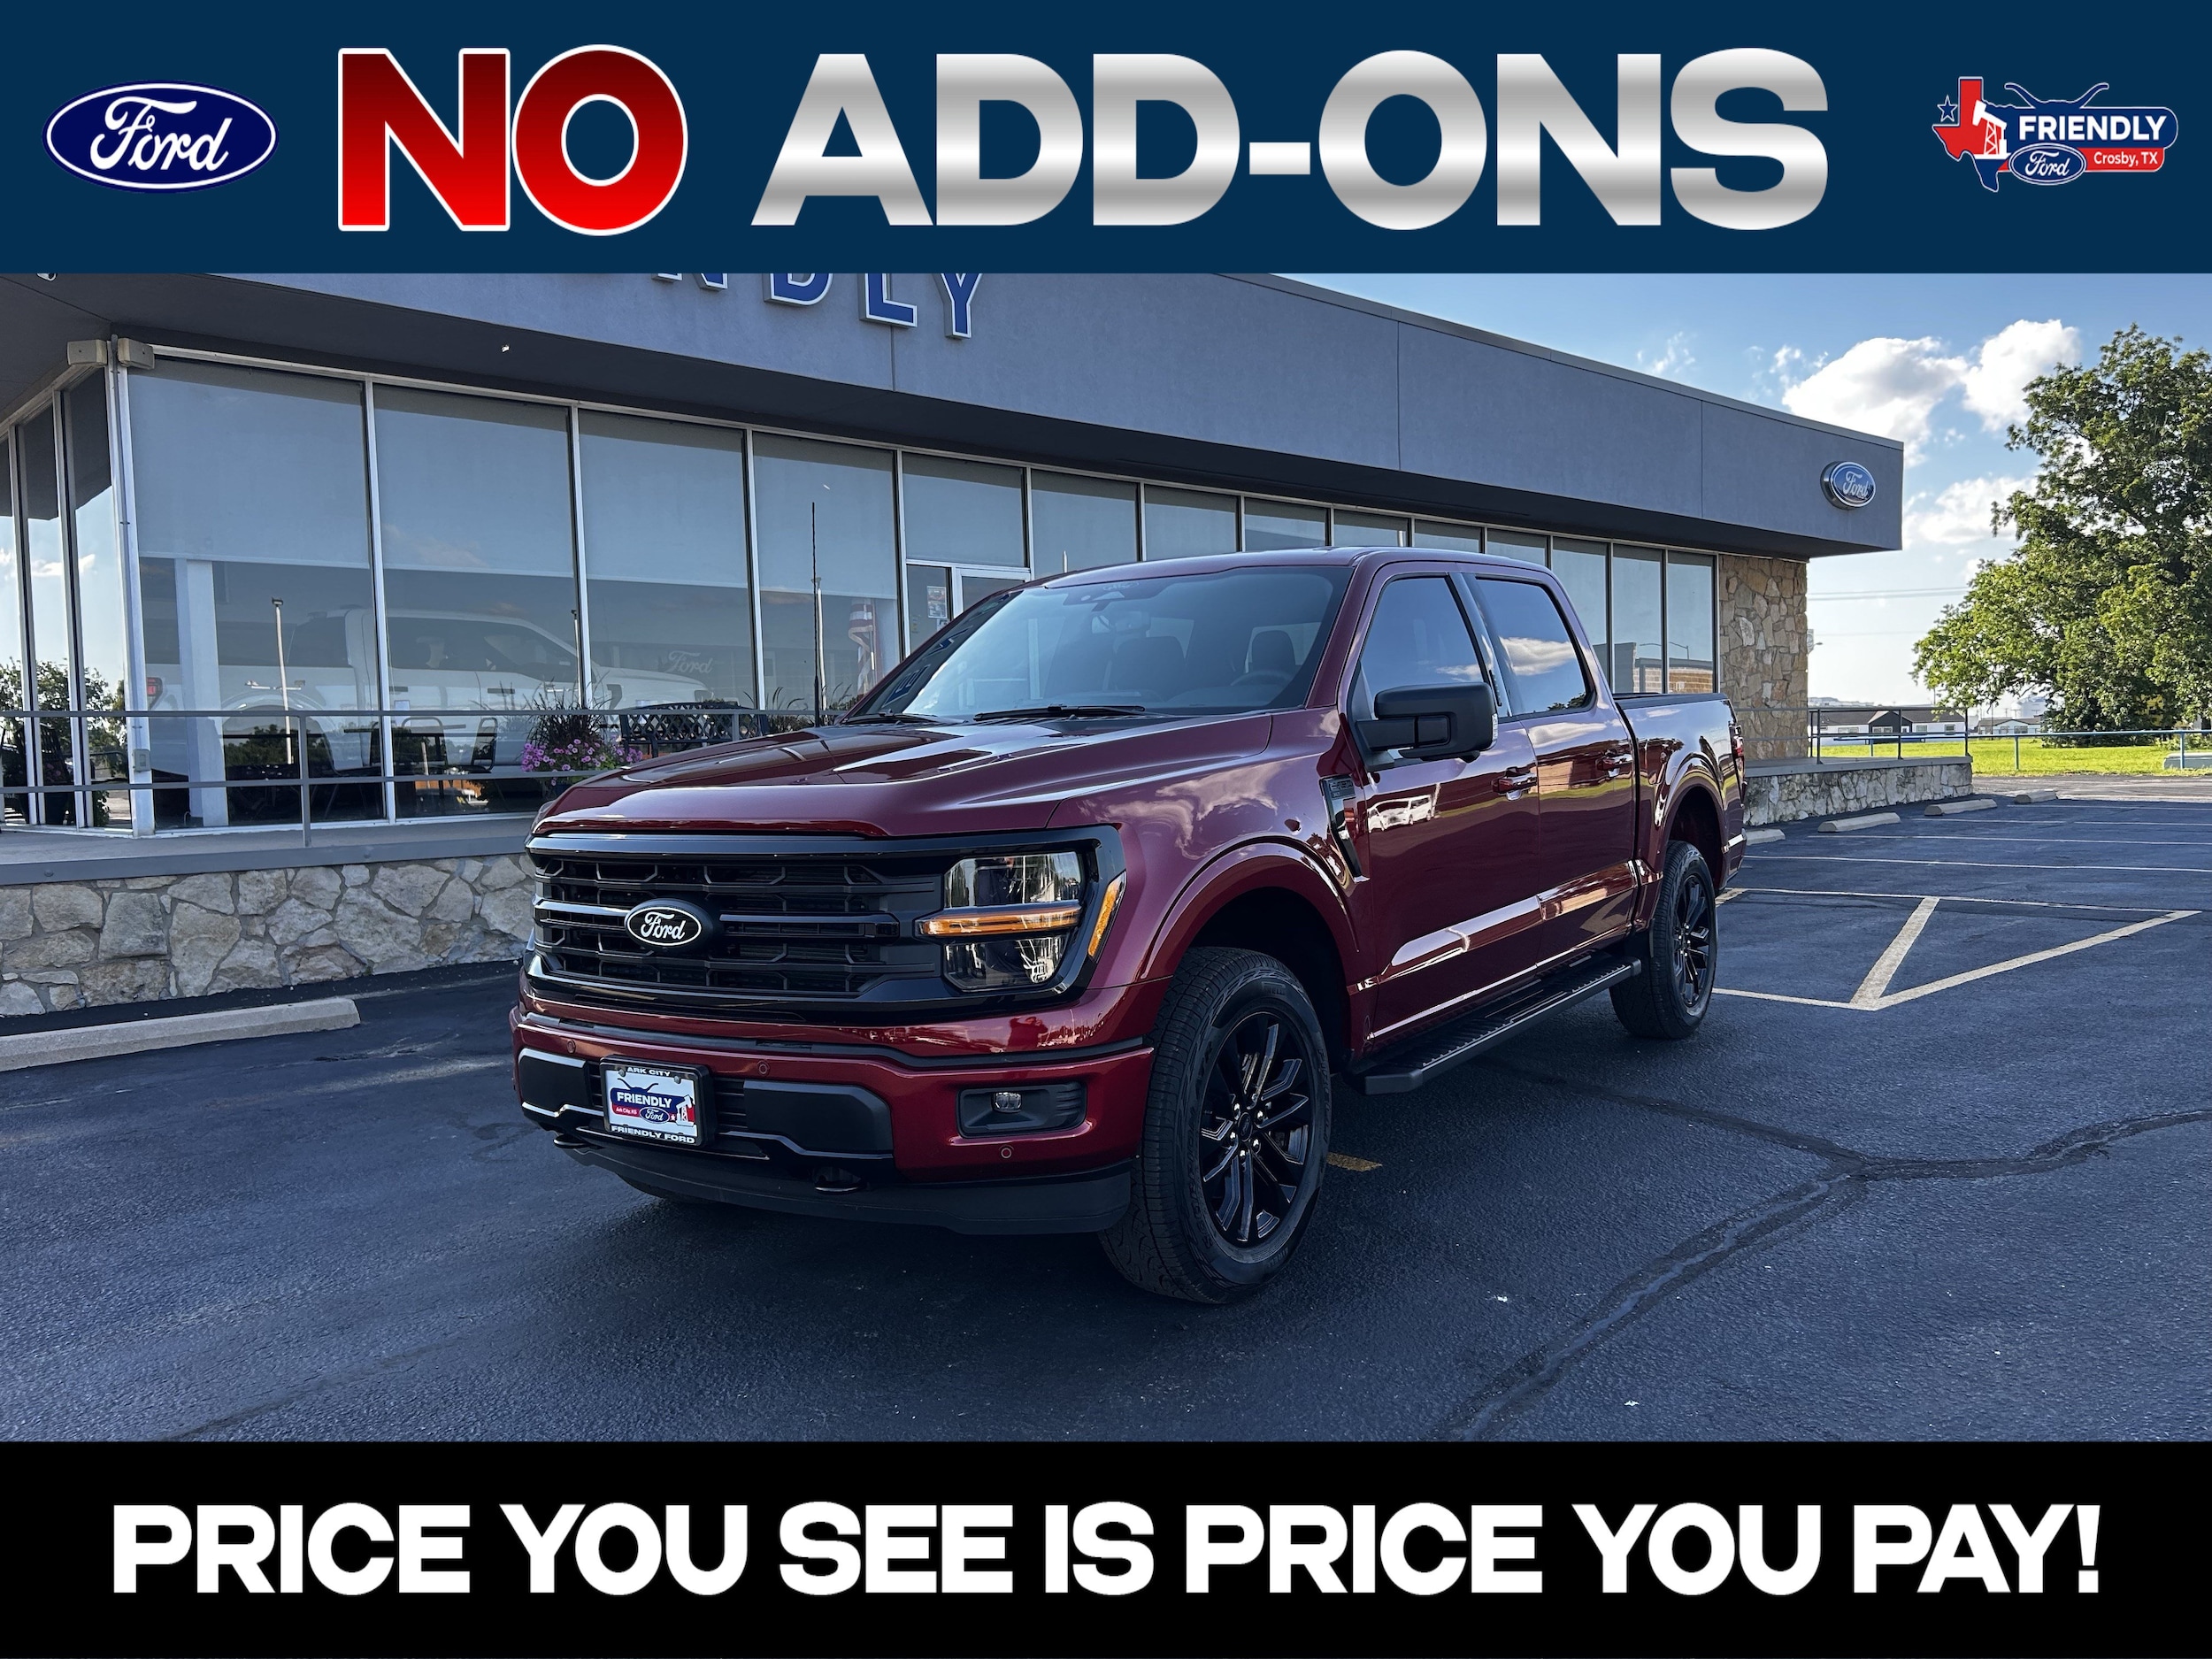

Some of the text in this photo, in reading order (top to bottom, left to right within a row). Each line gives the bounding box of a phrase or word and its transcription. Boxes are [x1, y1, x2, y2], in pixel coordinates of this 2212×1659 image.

[1842, 471, 1870, 498] Ford
[665, 650, 713, 673] Ford
[641, 911, 687, 941] Ford
[616, 1092, 672, 1108] FRIENDLY
[644, 1109, 664, 1121] Ford
[611, 1125, 695, 1144] FRIENDLY FORD
